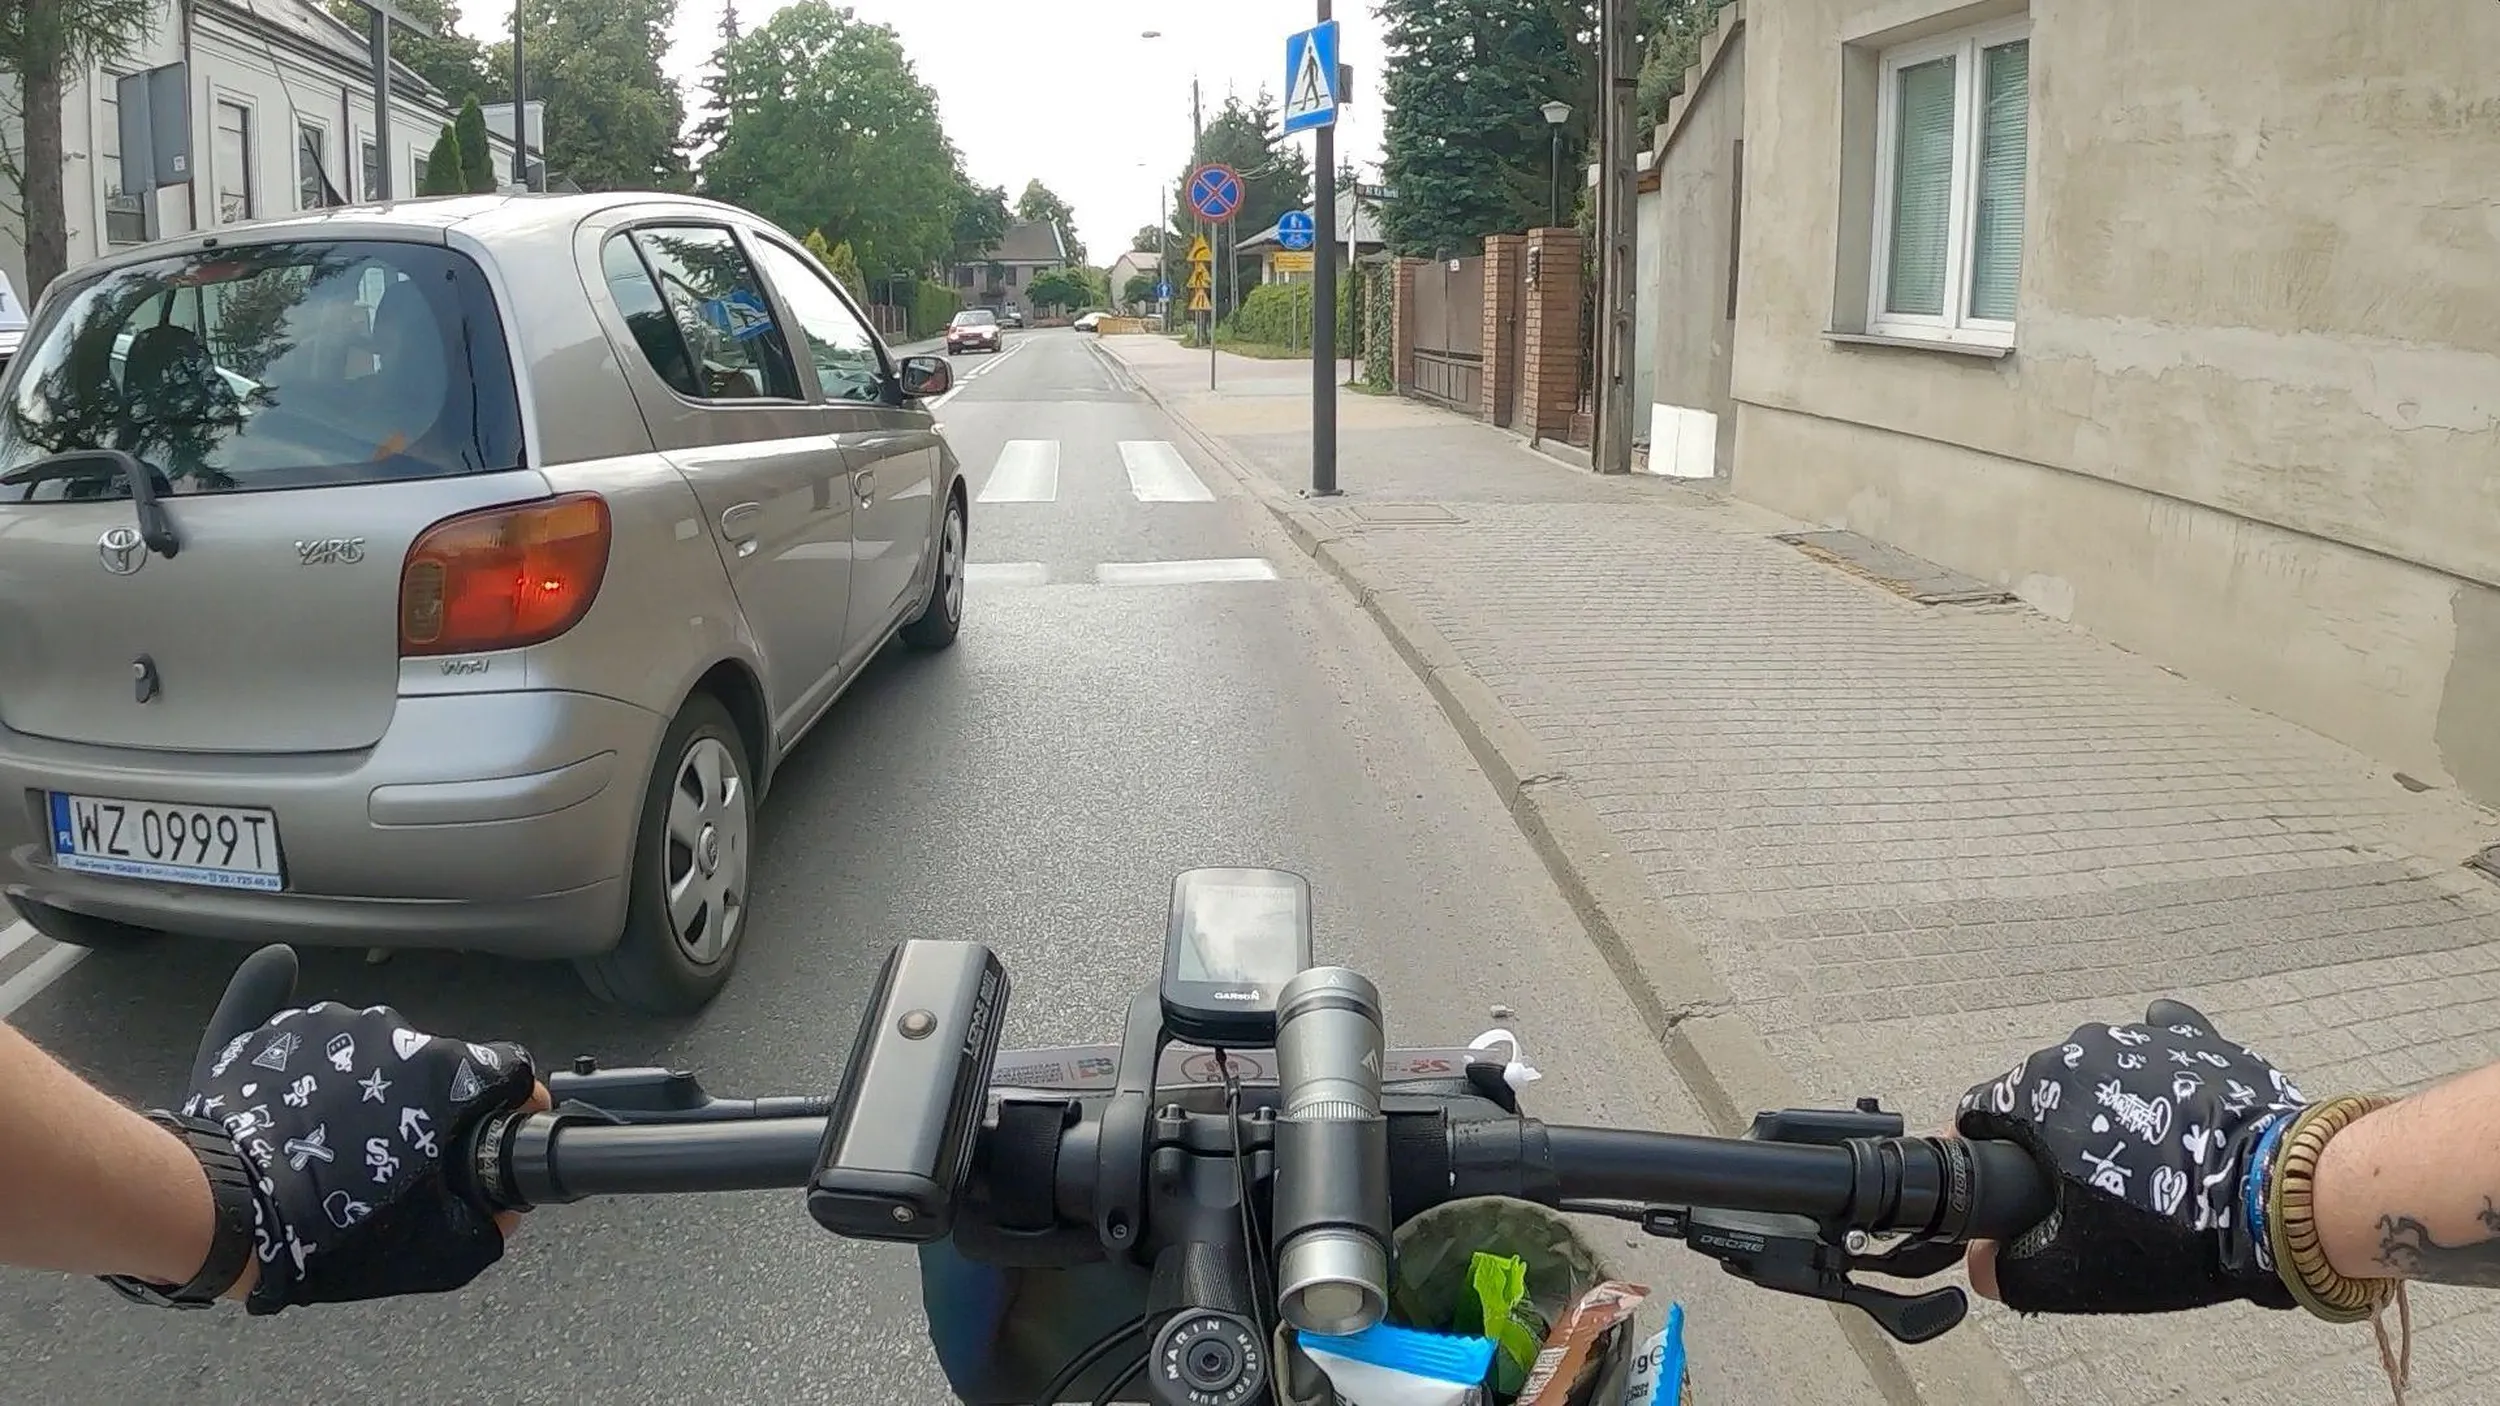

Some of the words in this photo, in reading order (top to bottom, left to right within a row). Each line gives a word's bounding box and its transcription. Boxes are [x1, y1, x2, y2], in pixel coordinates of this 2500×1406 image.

[295, 537, 365, 565] YARIS
[59, 831, 73, 846] PL
[76, 802, 129, 856] WZ
[142, 809, 266, 869] 0999T
[1700, 1234, 1765, 1252] DEORE
[1167, 1321, 1219, 1379] MARIN
[1237, 1333, 1256, 1370] MADE
[1189, 1391, 1218, 1405] FUN
[1226, 1376, 1251, 1400] FOR
